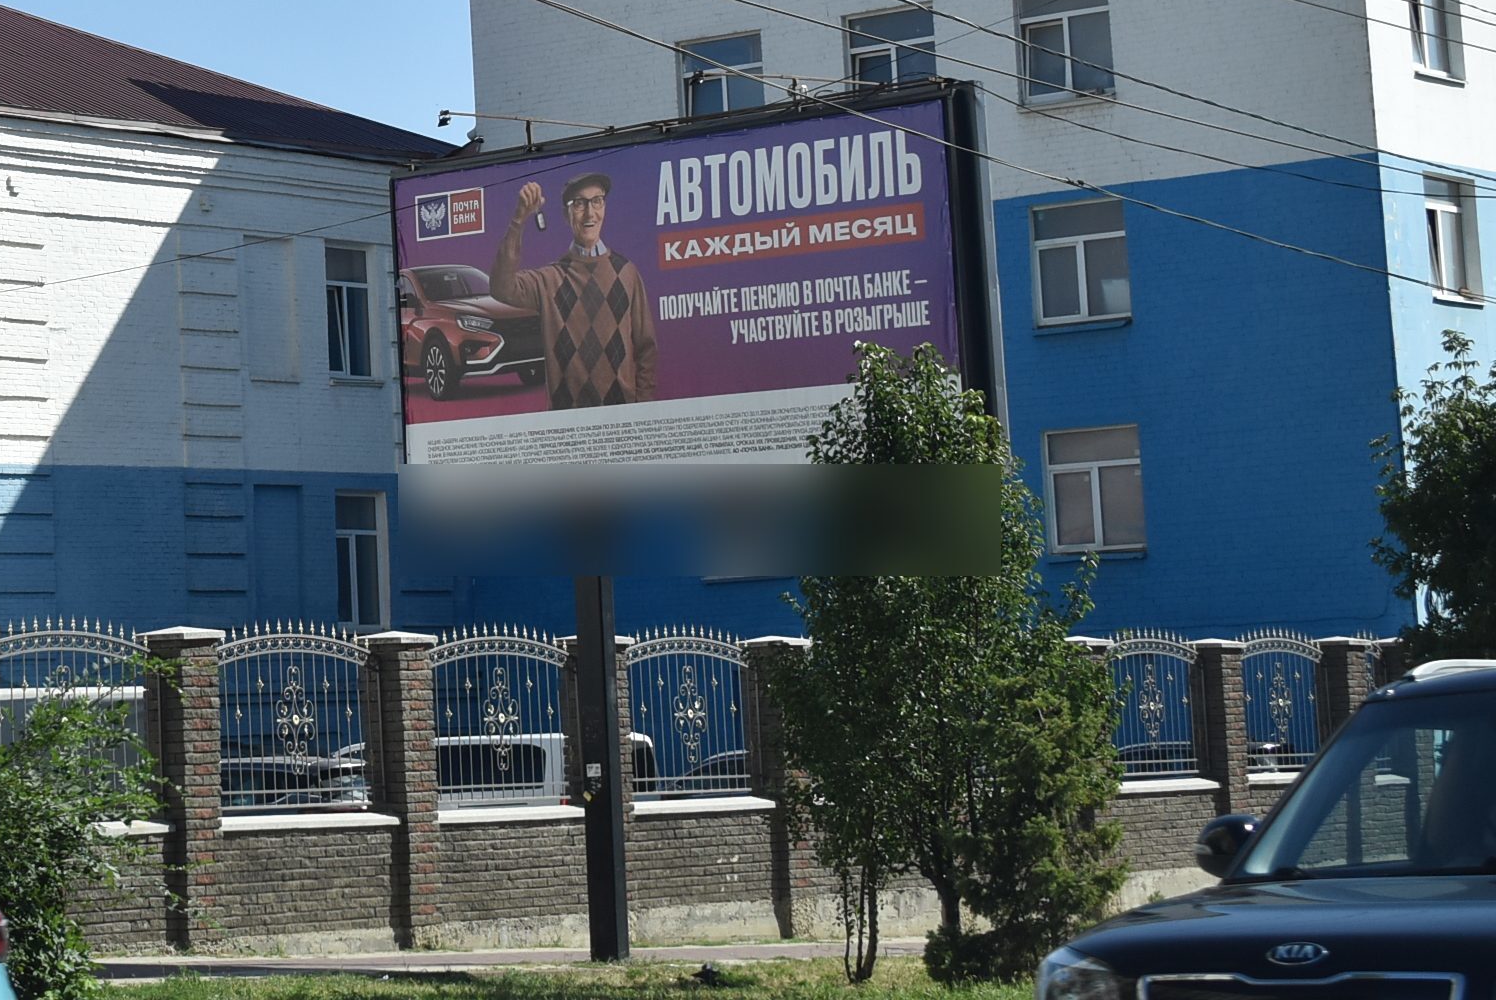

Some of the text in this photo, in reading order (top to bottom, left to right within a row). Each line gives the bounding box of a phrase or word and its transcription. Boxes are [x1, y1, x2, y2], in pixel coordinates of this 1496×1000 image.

[656, 129, 922, 226] АВТОМОБИЛЬ
[452, 200, 480, 213] ПОЧТА
[453, 212, 476, 225] БАНК
[664, 213, 917, 261] КАЖДЫЙ МЕСЯЦ
[659, 286, 739, 320] ПОЛУЧАЙТЕ
[741, 280, 800, 312] ПЕНСИЮ
[803, 280, 812, 305] В
[815, 275, 862, 304] ПОЧТА
[863, 269, 912, 299] БАНКЕ
[730, 300, 931, 345] УЧАСТВУЙТЕ В РОЗЫГРЫШЕ
[1275, 944, 1314, 959] KIA
